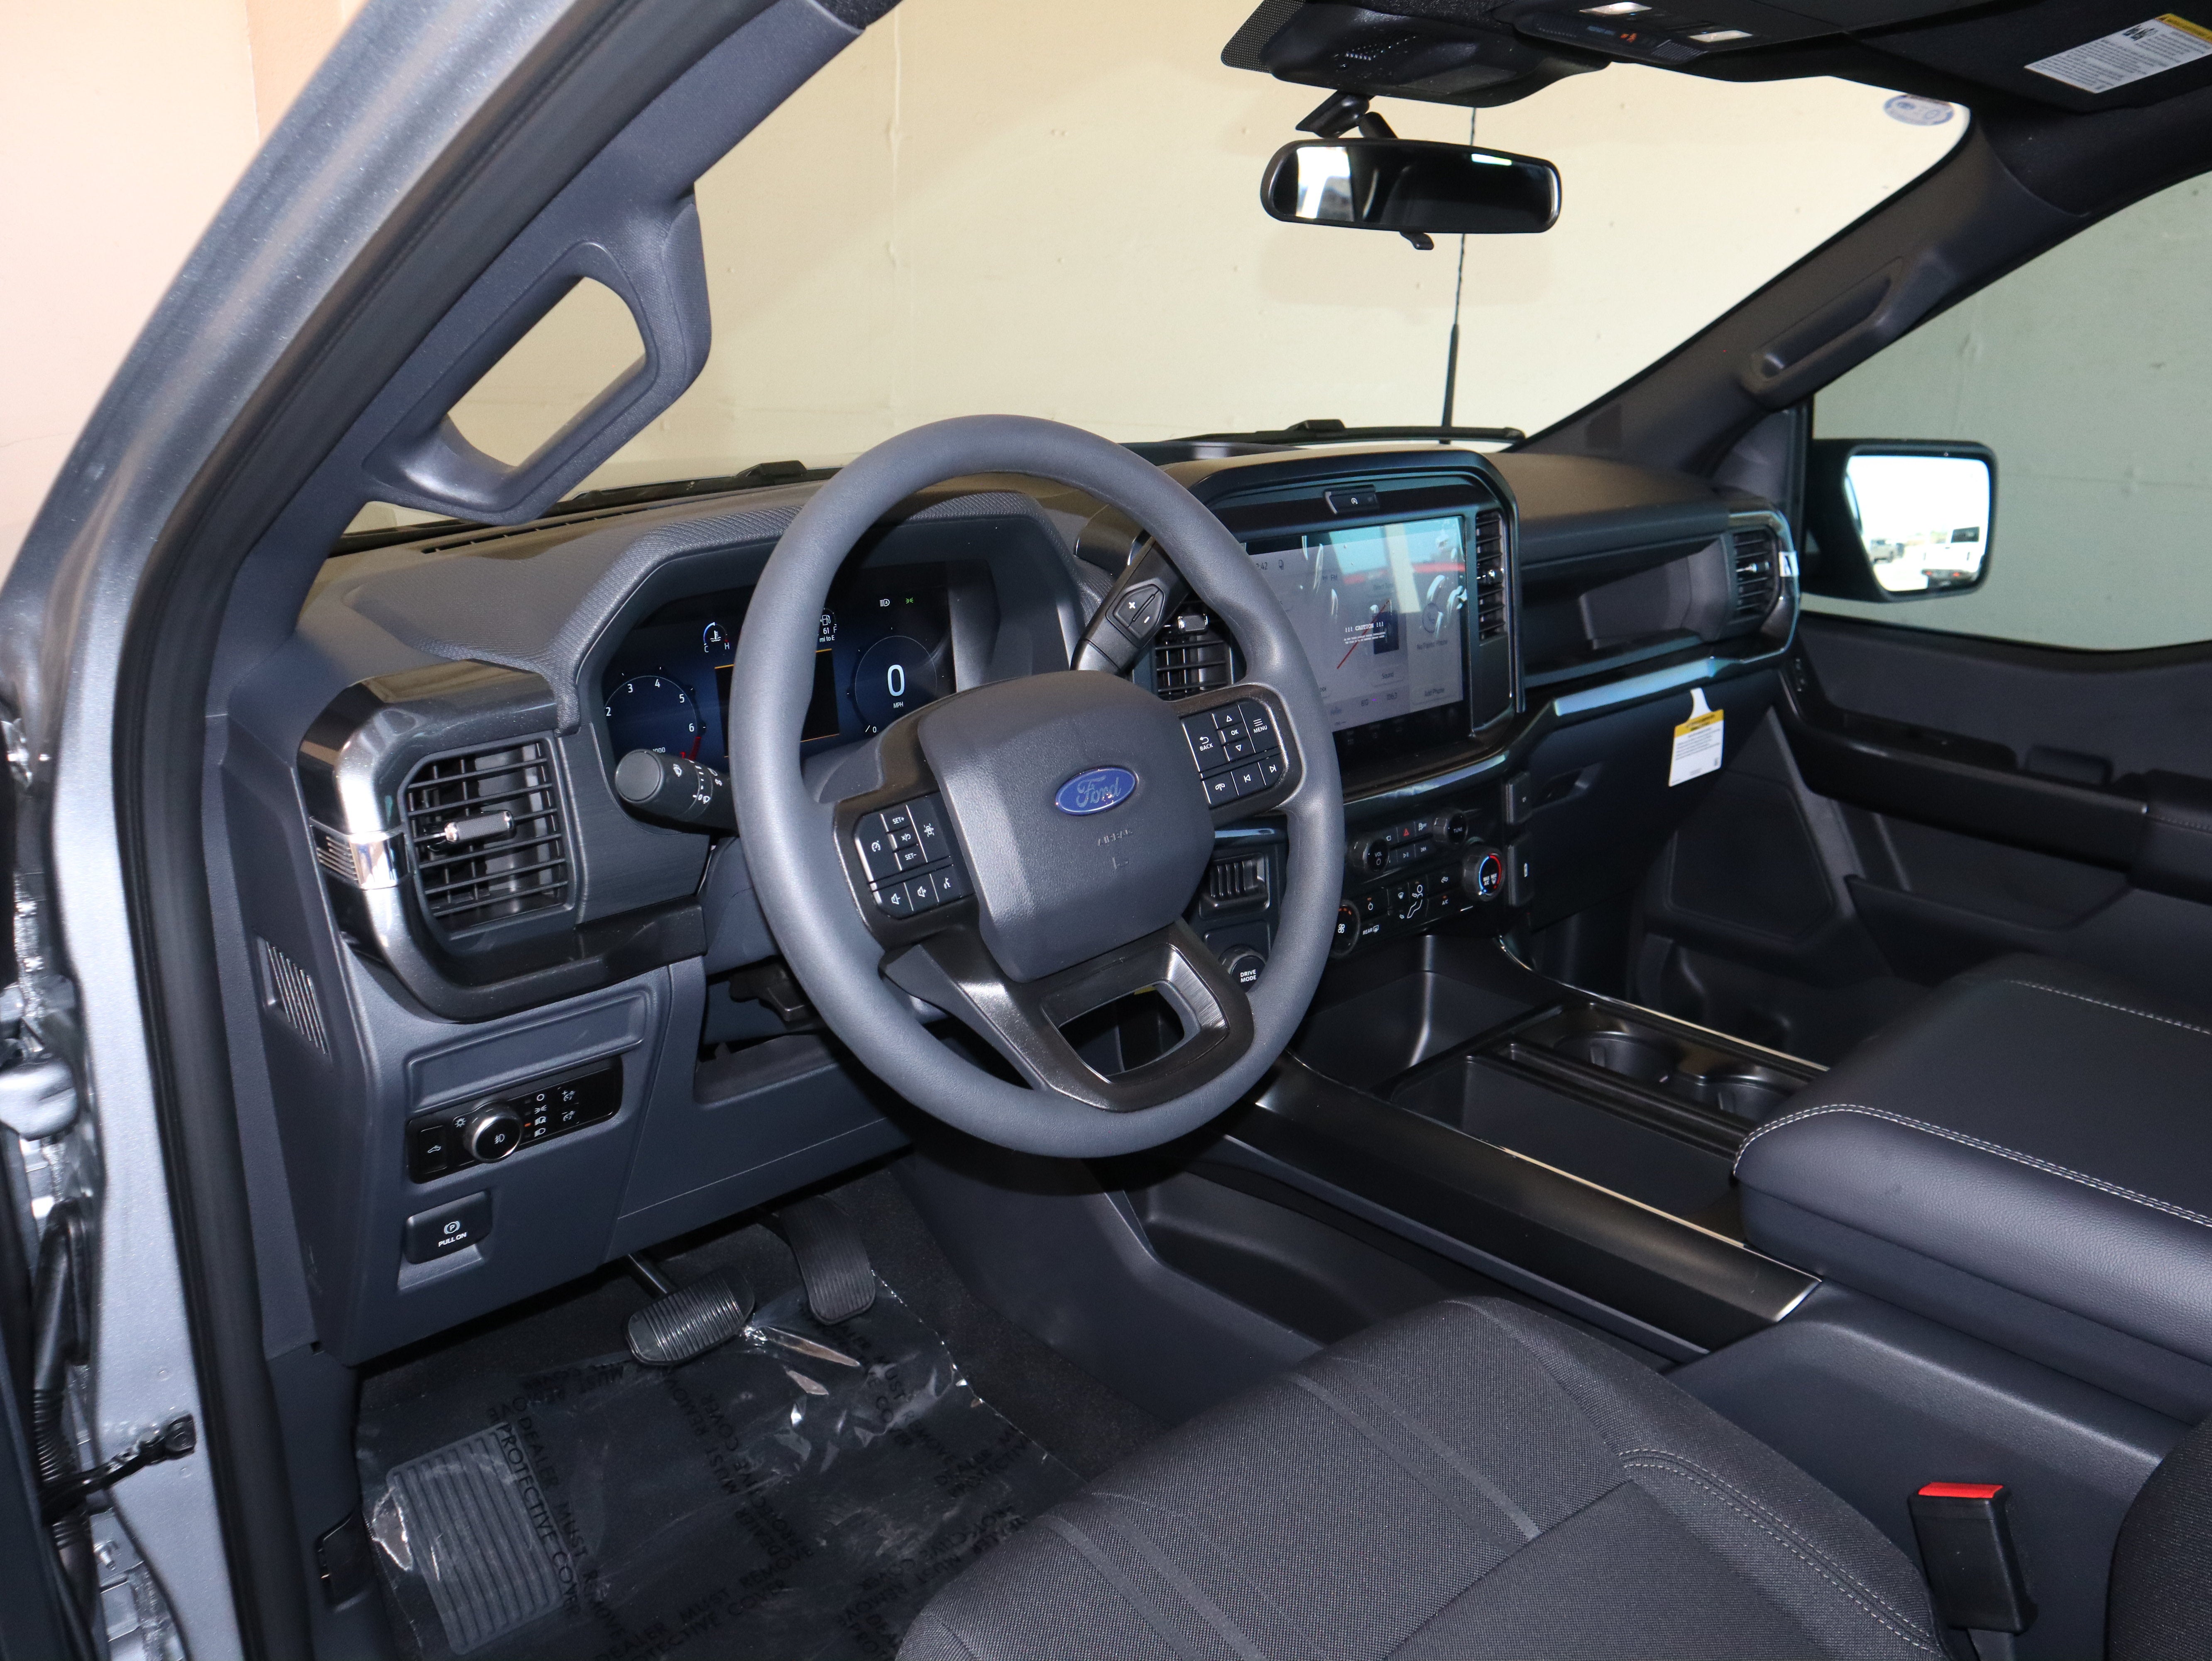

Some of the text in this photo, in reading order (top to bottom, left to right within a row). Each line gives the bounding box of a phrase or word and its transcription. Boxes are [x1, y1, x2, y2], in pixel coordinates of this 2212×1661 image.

[655, 679, 661, 688] 4
[887, 664, 905, 696] 0
[627, 684, 633, 693] 3
[679, 694, 685, 703] 5
[606, 707, 612, 716] 2
[689, 723, 694, 732] 6
[1253, 725, 1267, 734] MENU
[1199, 743, 1214, 752] BACK
[1076, 775, 1122, 808] Ford
[1240, 969, 1256, 977] DRIVE
[1241, 975, 1257, 983] MODE
[438, 1231, 467, 1247] PULL ON
[498, 1423, 582, 1619] PROTECTIVE COVER
[679, 1587, 731, 1624] MUST
